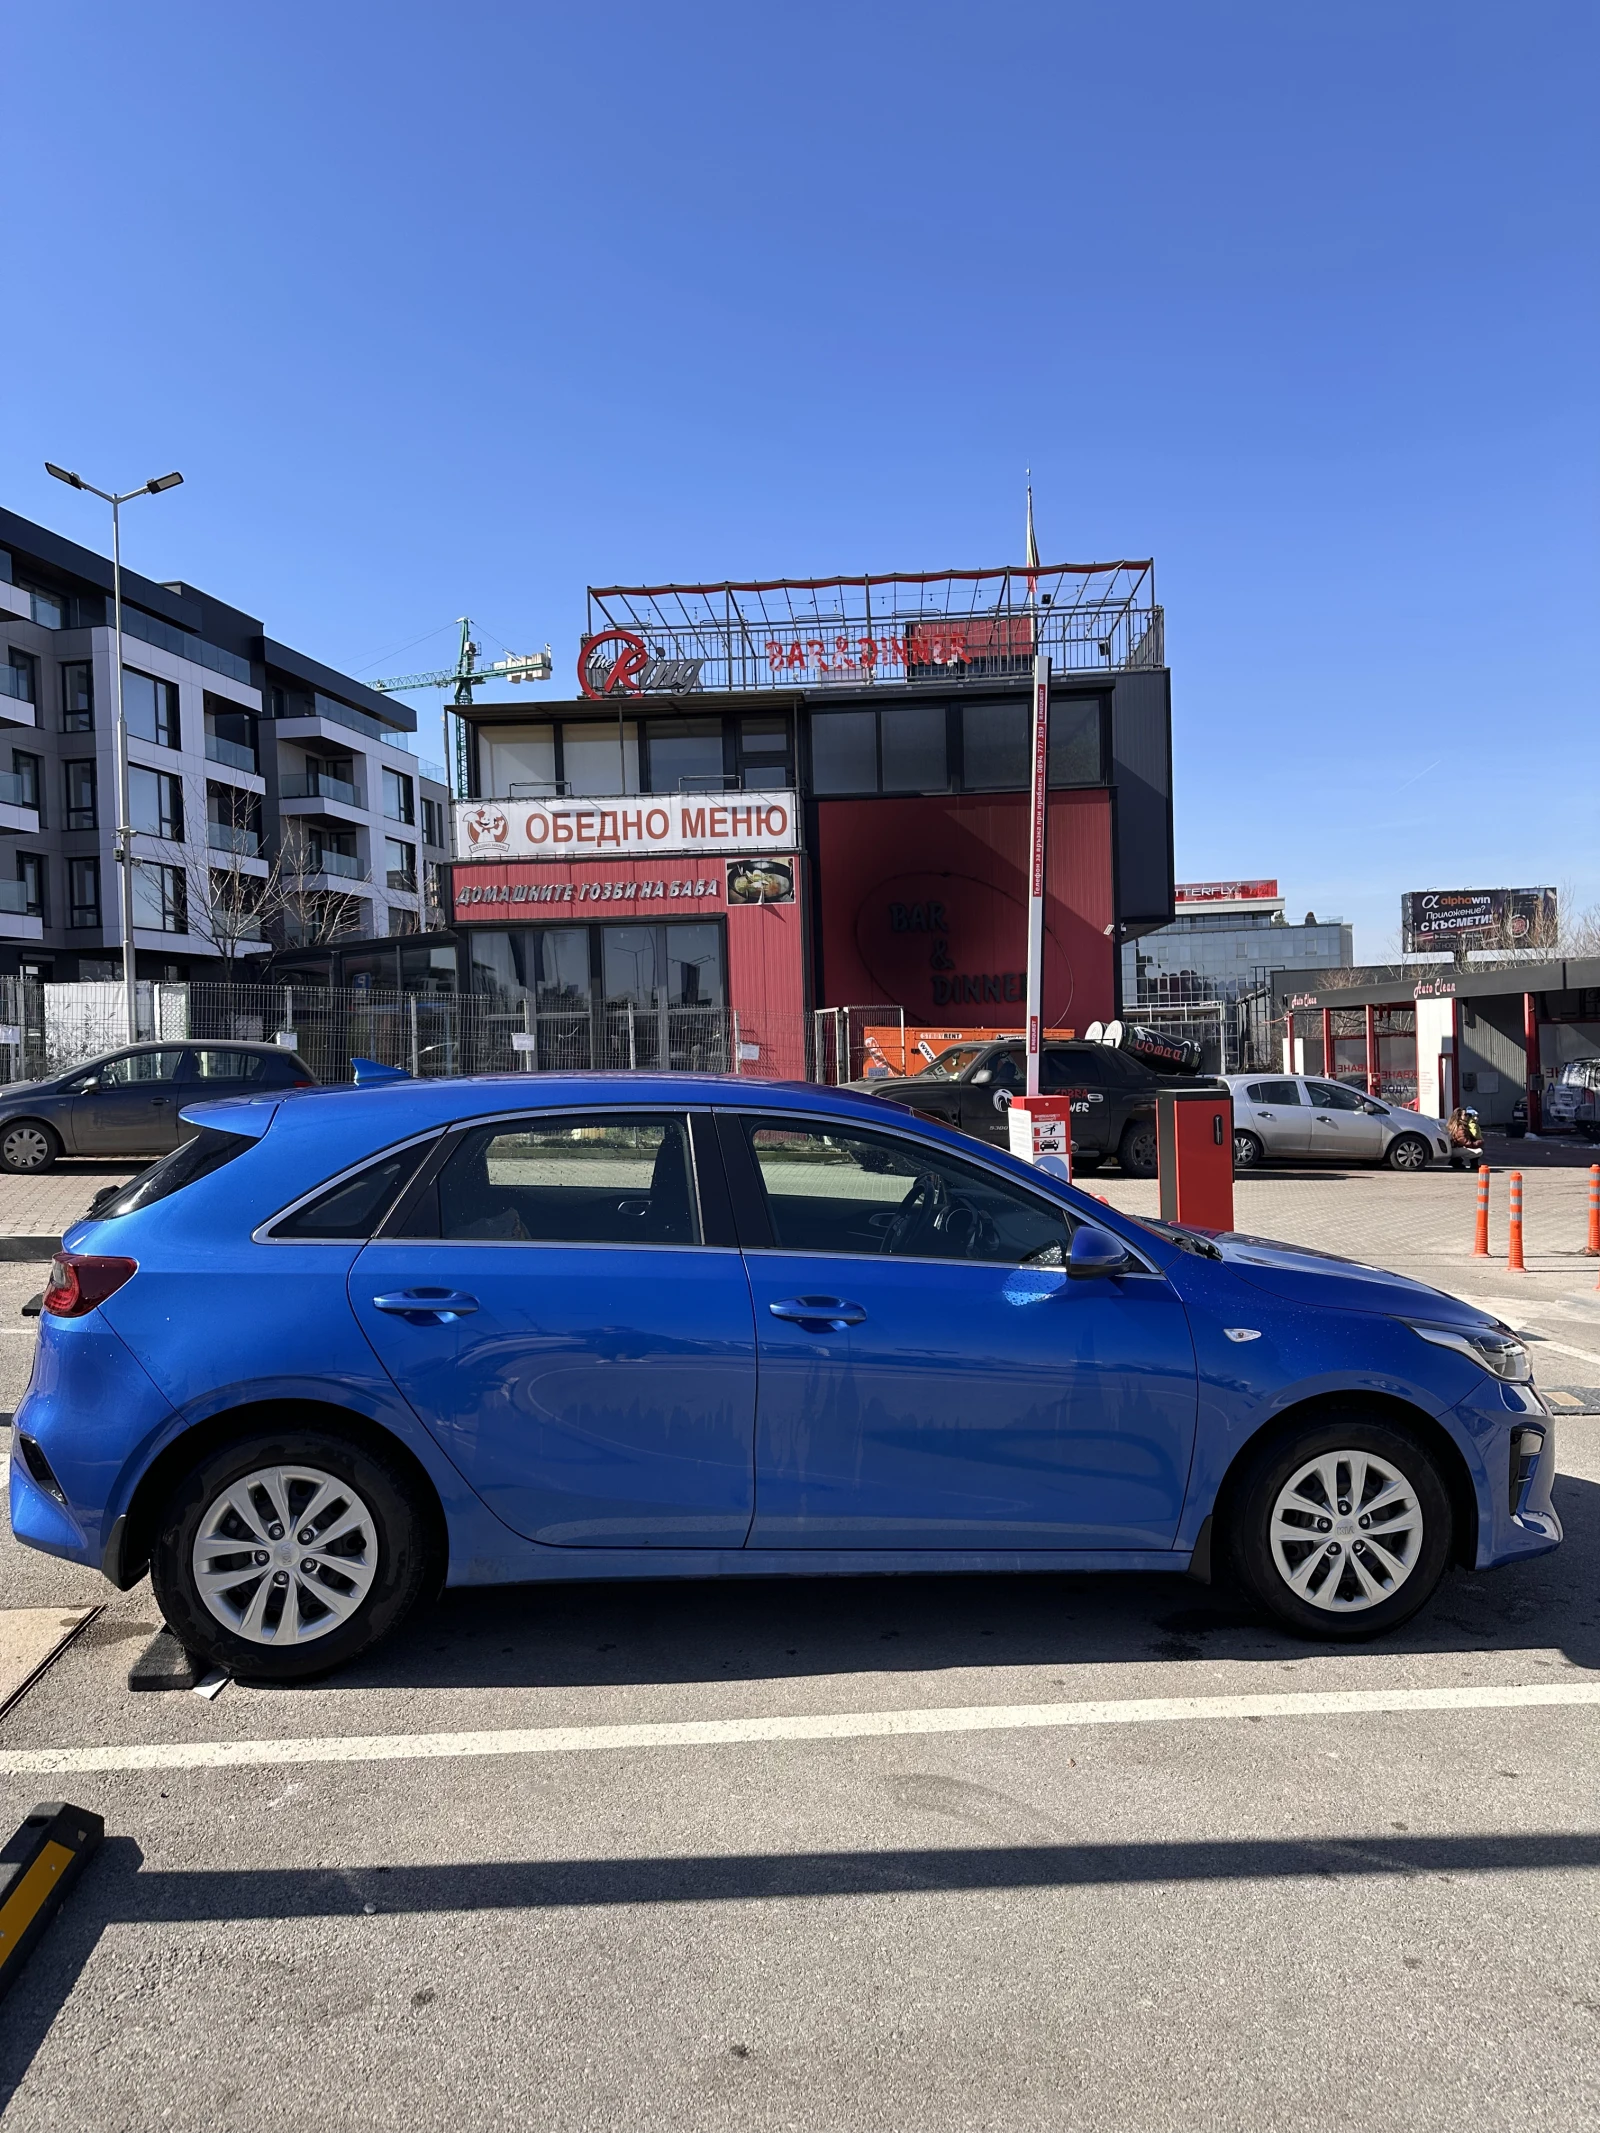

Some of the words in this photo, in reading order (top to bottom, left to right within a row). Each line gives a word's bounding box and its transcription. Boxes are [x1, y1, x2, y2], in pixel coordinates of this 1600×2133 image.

[588, 653, 616, 669] The
[604, 647, 704, 696] Ring
[526, 808, 670, 848] ОБЕДНО
[681, 805, 788, 839] МЕНЮ
[1034, 863, 1042, 895] Телефон
[455, 884, 574, 905] ДОМАШНИТЕ
[579, 882, 637, 901] ГОЗБИ
[640, 881, 664, 899] НА
[669, 879, 718, 898] БАБА
[1175, 886, 1235, 897] TTERFLY
[1441, 895, 1491, 907] alphawin
[889, 901, 949, 932] BAR
[1426, 906, 1485, 919] Приложение?
[1431, 914, 1493, 930] КЪСМЕТИ!
[930, 938, 955, 970] &
[1413, 980, 1433, 998] Auto
[1435, 978, 1456, 995] Clean
[1337, 1526, 1354, 1535] KIA
